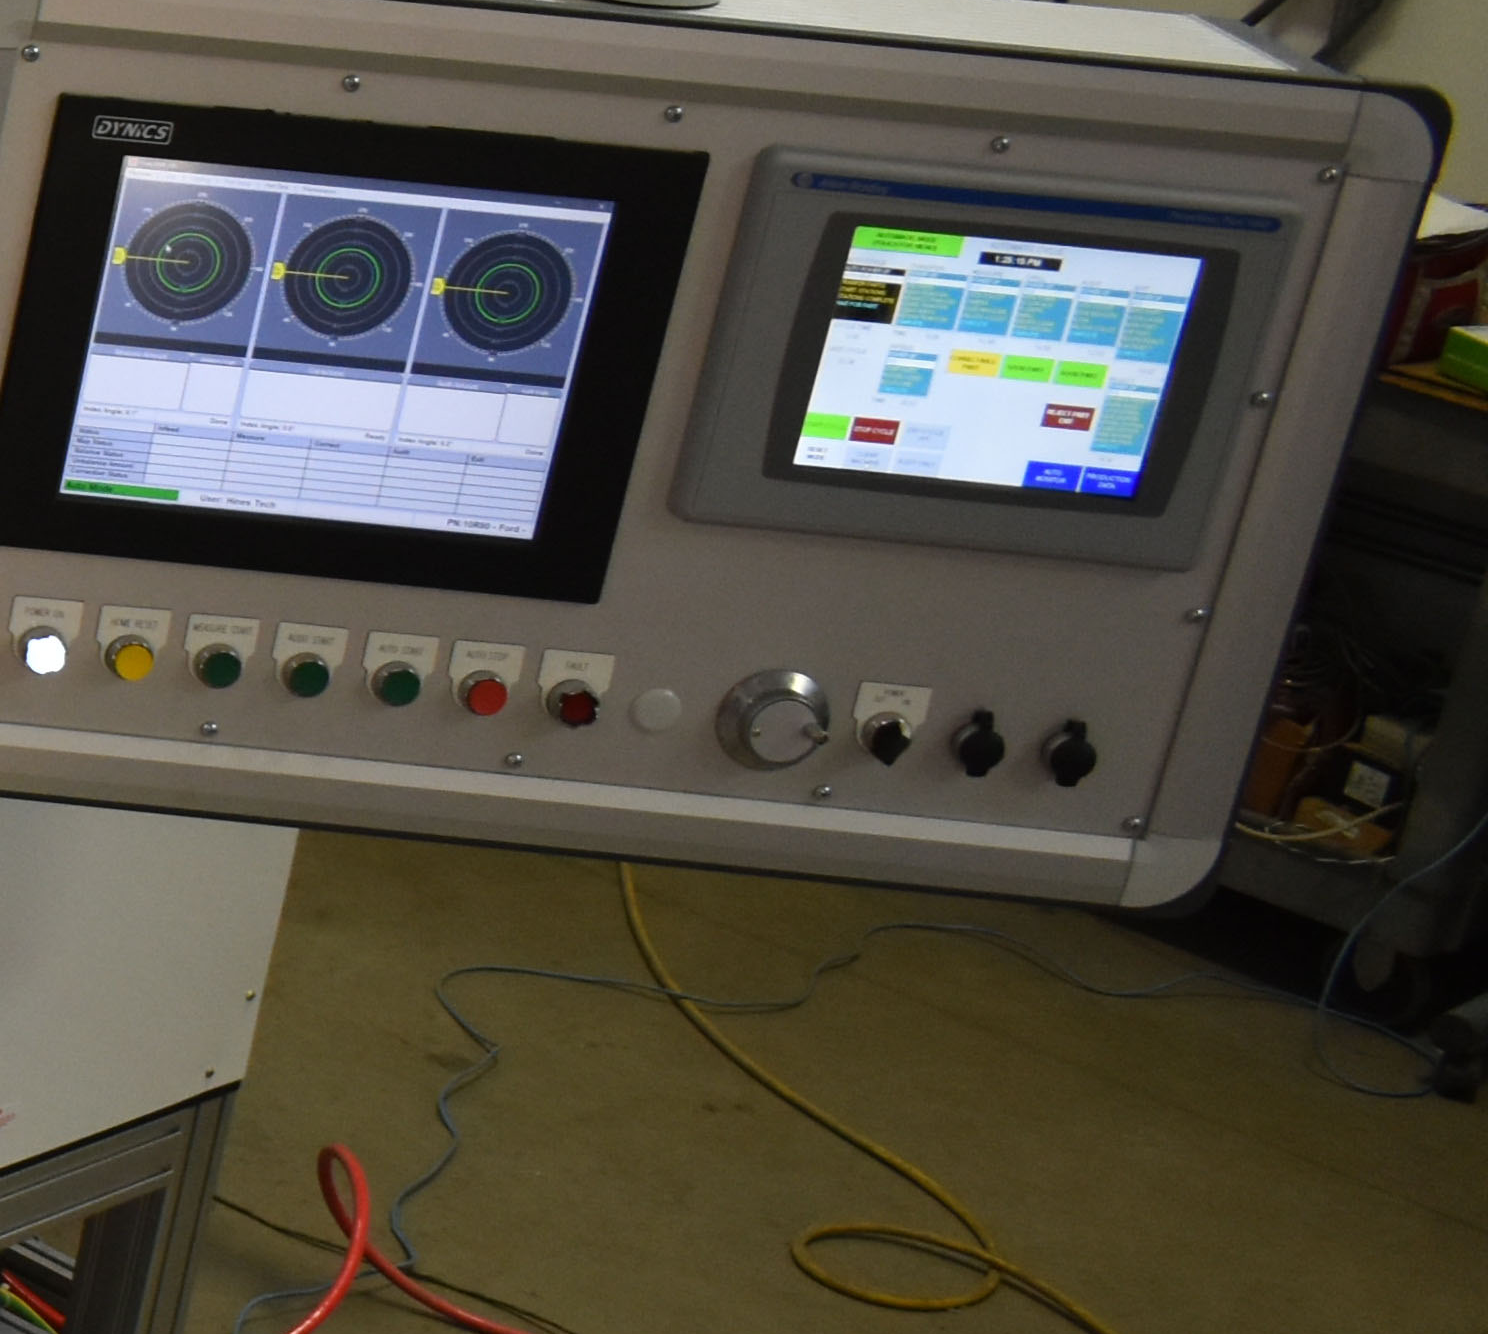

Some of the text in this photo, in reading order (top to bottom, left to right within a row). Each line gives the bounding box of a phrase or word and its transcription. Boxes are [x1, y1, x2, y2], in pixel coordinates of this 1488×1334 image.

[89, 484, 113, 494] Mode
[226, 496, 251, 507] Hines
[254, 499, 277, 509] Tech
[499, 524, 520, 534] Ford
[24, 607, 65, 619] POWER ON
[109, 618, 158, 630] HOME RESET
[193, 622, 254, 636] MEASURE START
[312, 636, 335, 646] START
[379, 643, 400, 654] AUTO
[466, 649, 510, 662] AUTO STOP
